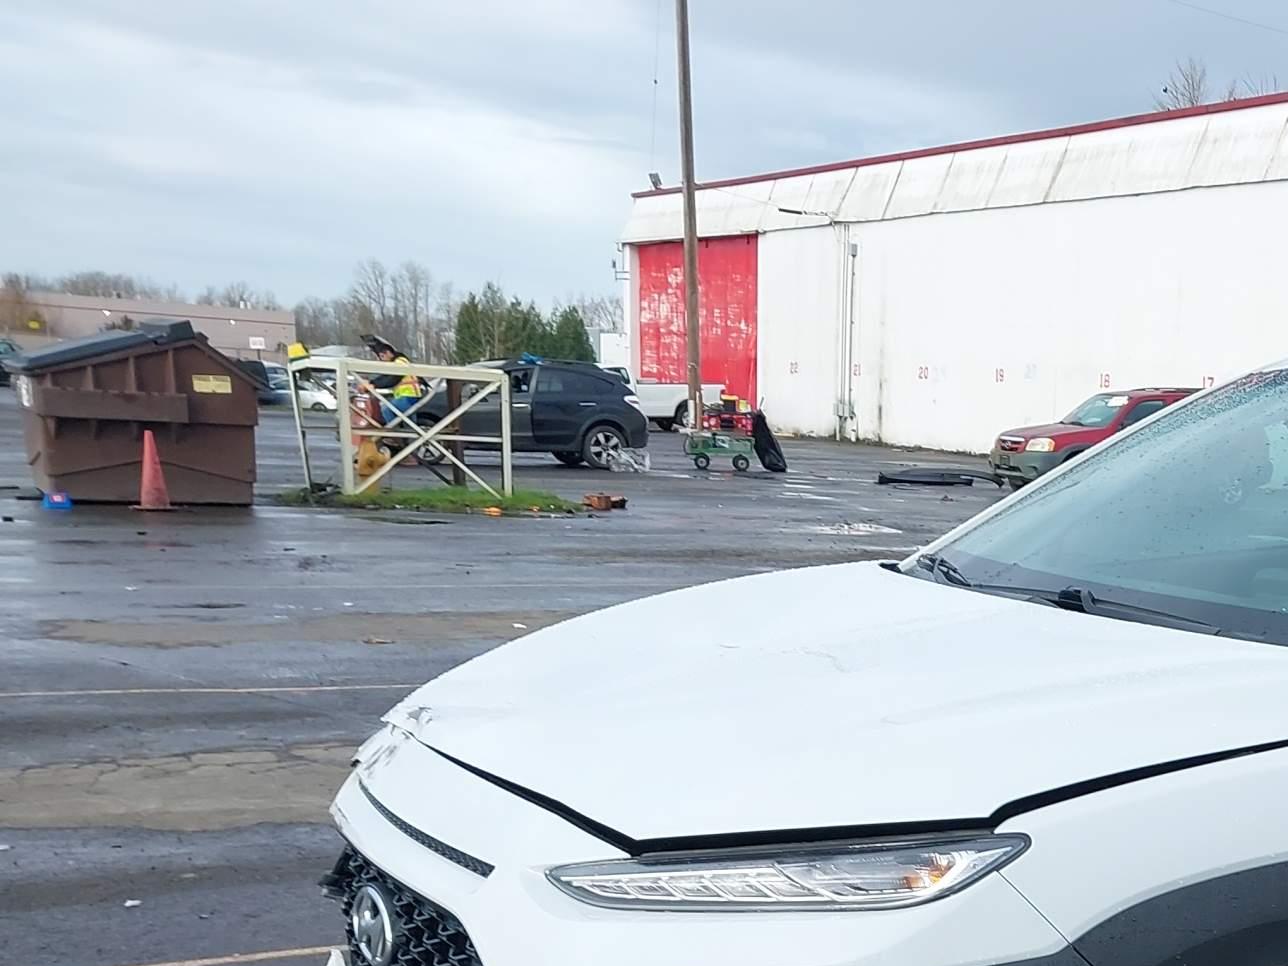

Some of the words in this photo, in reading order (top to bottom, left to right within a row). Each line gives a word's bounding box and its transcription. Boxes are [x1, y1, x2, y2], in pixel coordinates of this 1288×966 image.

[917, 366, 929, 380] 20
[995, 367, 1005, 383] 19
[1100, 373, 1110, 389] 18
[1202, 375, 1215, 388] 17
